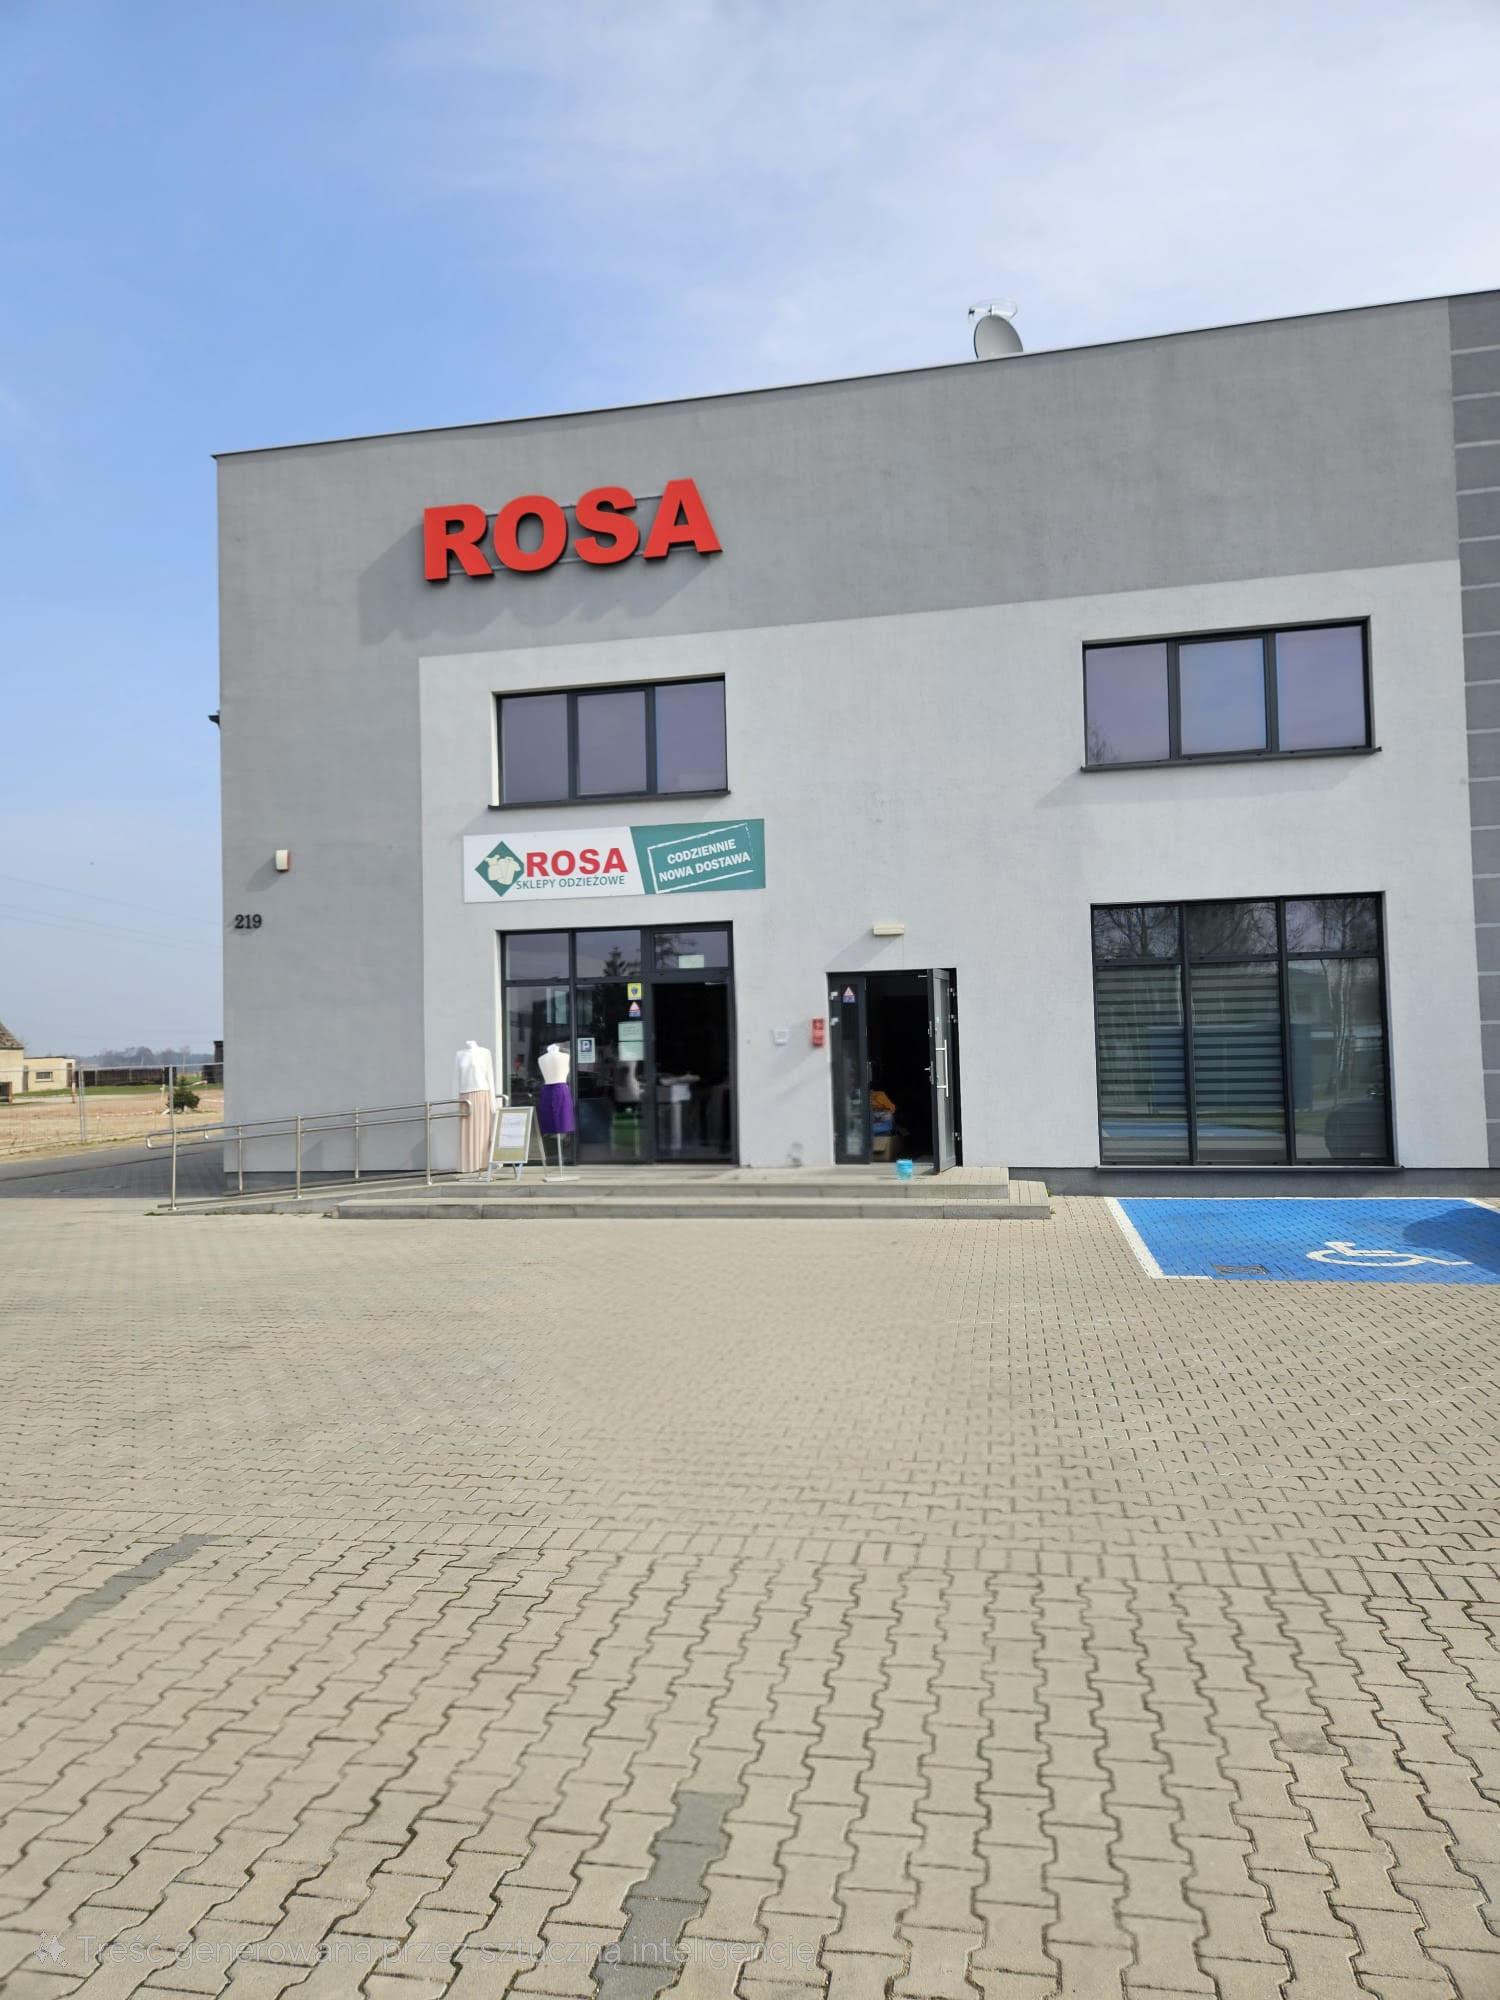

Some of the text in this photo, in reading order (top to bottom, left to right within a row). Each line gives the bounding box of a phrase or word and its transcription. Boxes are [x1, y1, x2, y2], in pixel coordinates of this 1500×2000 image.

[423, 477, 723, 582] ROSA
[526, 847, 629, 877] ROSA
[667, 838, 737, 865] CODZIENNIE
[658, 851, 752, 883] NOWA DOSTAWA
[515, 874, 625, 890] SKLEPY ODZIEŻOWE
[234, 913, 262, 929] 219
